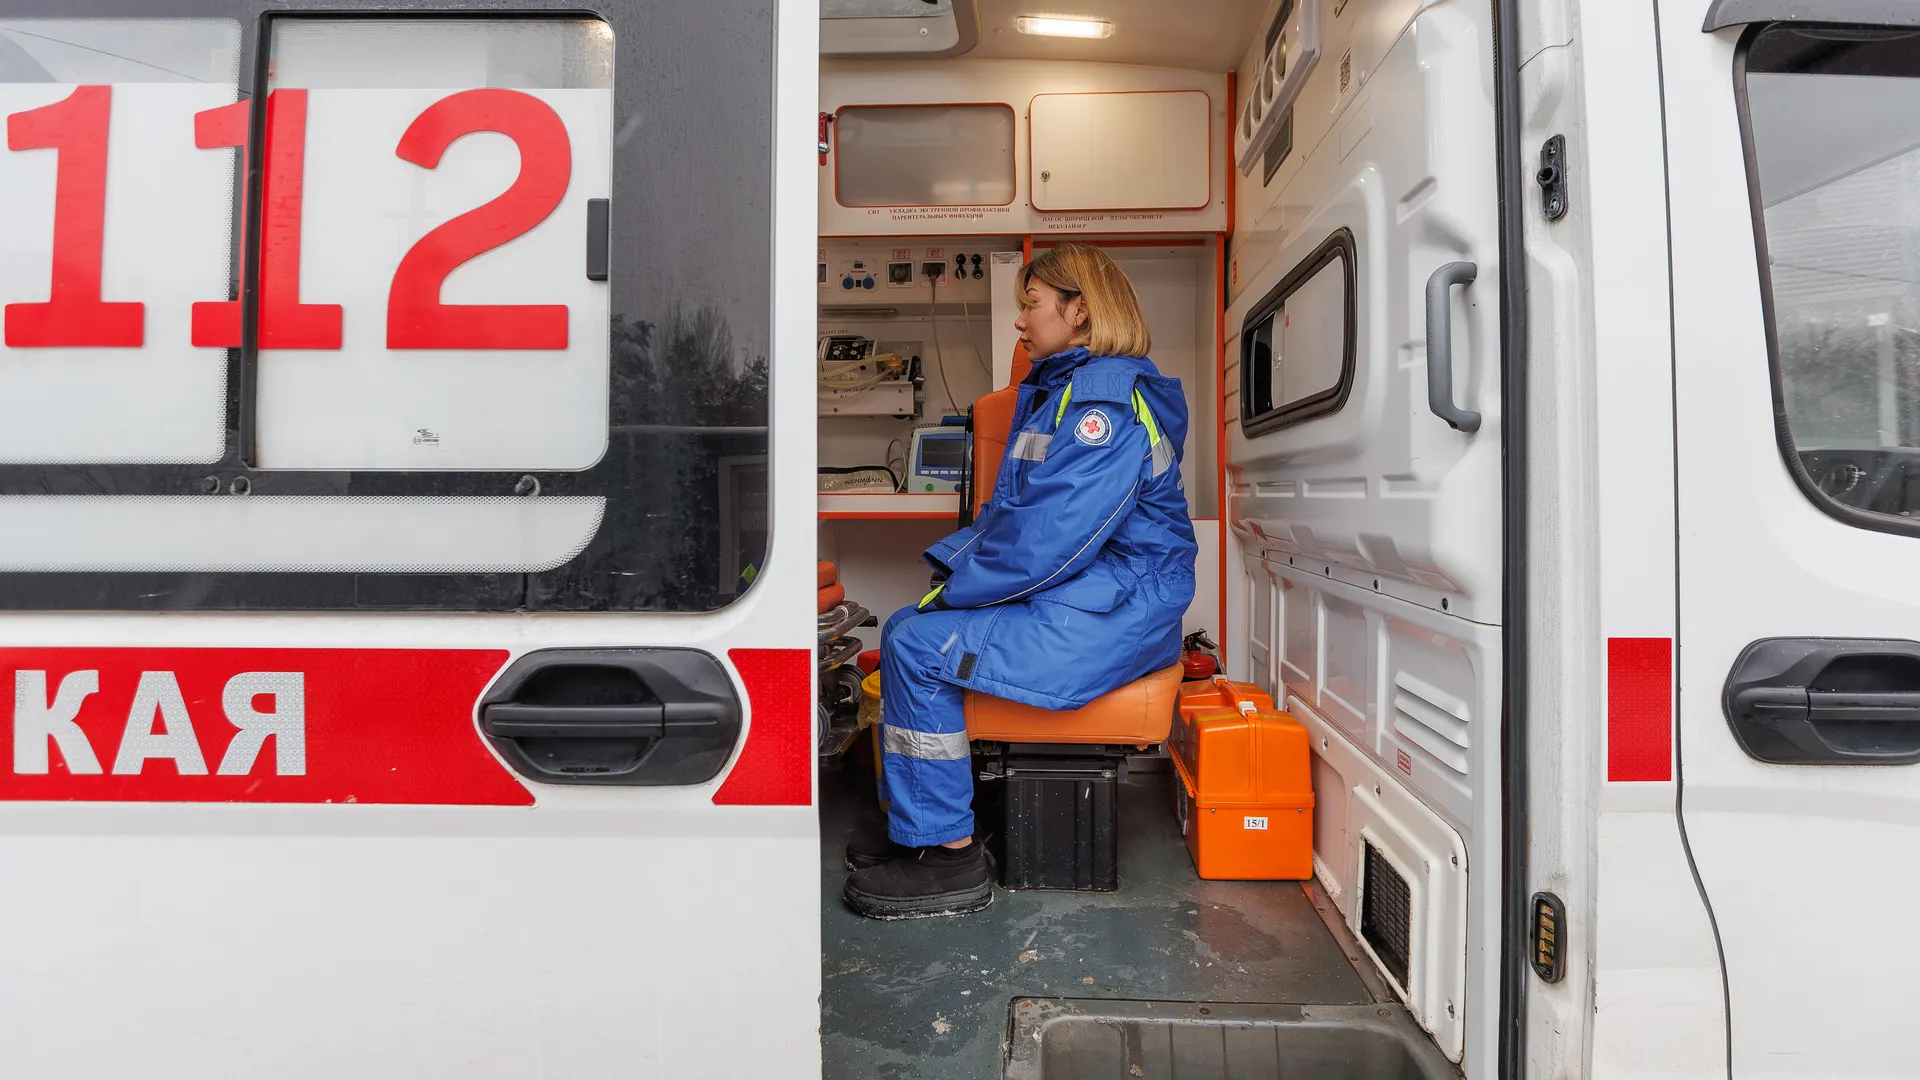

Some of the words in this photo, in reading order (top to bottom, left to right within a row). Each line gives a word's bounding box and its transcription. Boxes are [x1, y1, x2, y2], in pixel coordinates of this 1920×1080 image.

[5, 85, 572, 351] 112
[14, 670, 306, 776] КАЯ
[1247, 819, 1265, 828] 15/1
